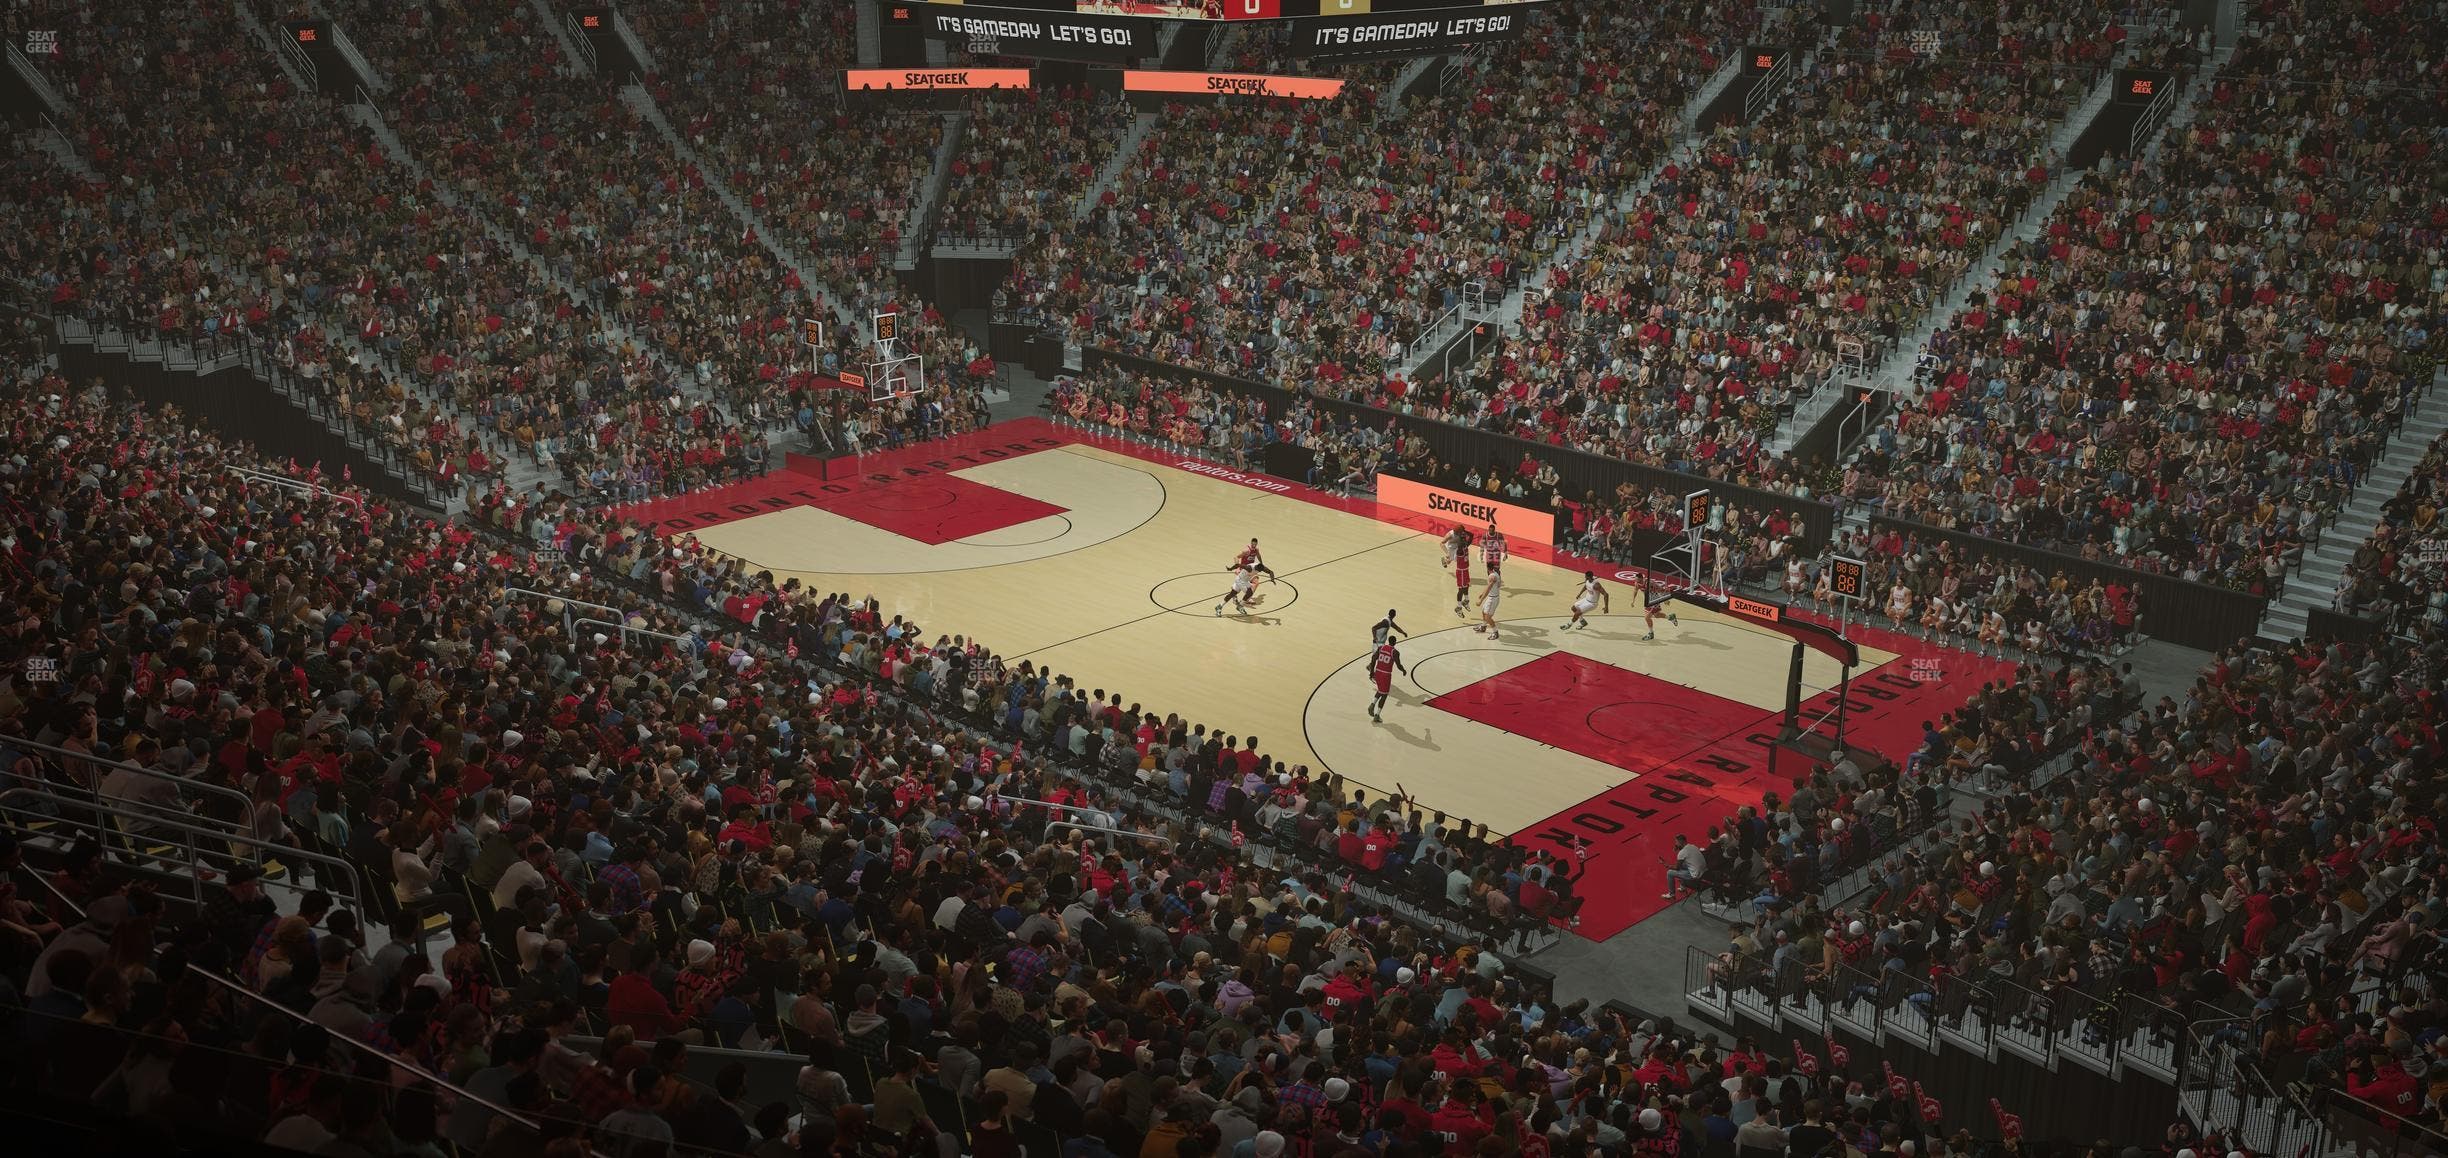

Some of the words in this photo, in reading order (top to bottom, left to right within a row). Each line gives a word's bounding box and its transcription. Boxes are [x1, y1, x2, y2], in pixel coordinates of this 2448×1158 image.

[937, 16, 961, 32] IT'S
[964, 18, 1040, 39] GAMEDAY
[1050, 24, 1097, 43] LET'S
[1101, 28, 1132, 46] GO!
[1316, 26, 1349, 45] IT'S
[1352, 21, 1438, 43] GAMEDAY
[1447, 18, 1485, 35] LET'S
[1487, 16, 1511, 32] GO!
[905, 72, 968, 85] SEATGEEK
[1208, 77, 1267, 92] SEATGEEK
[881, 326, 892, 338] 88
[1177, 460, 1291, 492] raptors.com
[1428, 493, 1498, 524] SEATGEEK
[1693, 507, 1704, 524] 88
[1838, 575, 1856, 594] 88
[1734, 600, 1772, 618] SEATGEEK
[1379, 654, 1391, 663] 00
[1327, 997, 1340, 1006] 00
[2397, 1091, 2412, 1104] 00
